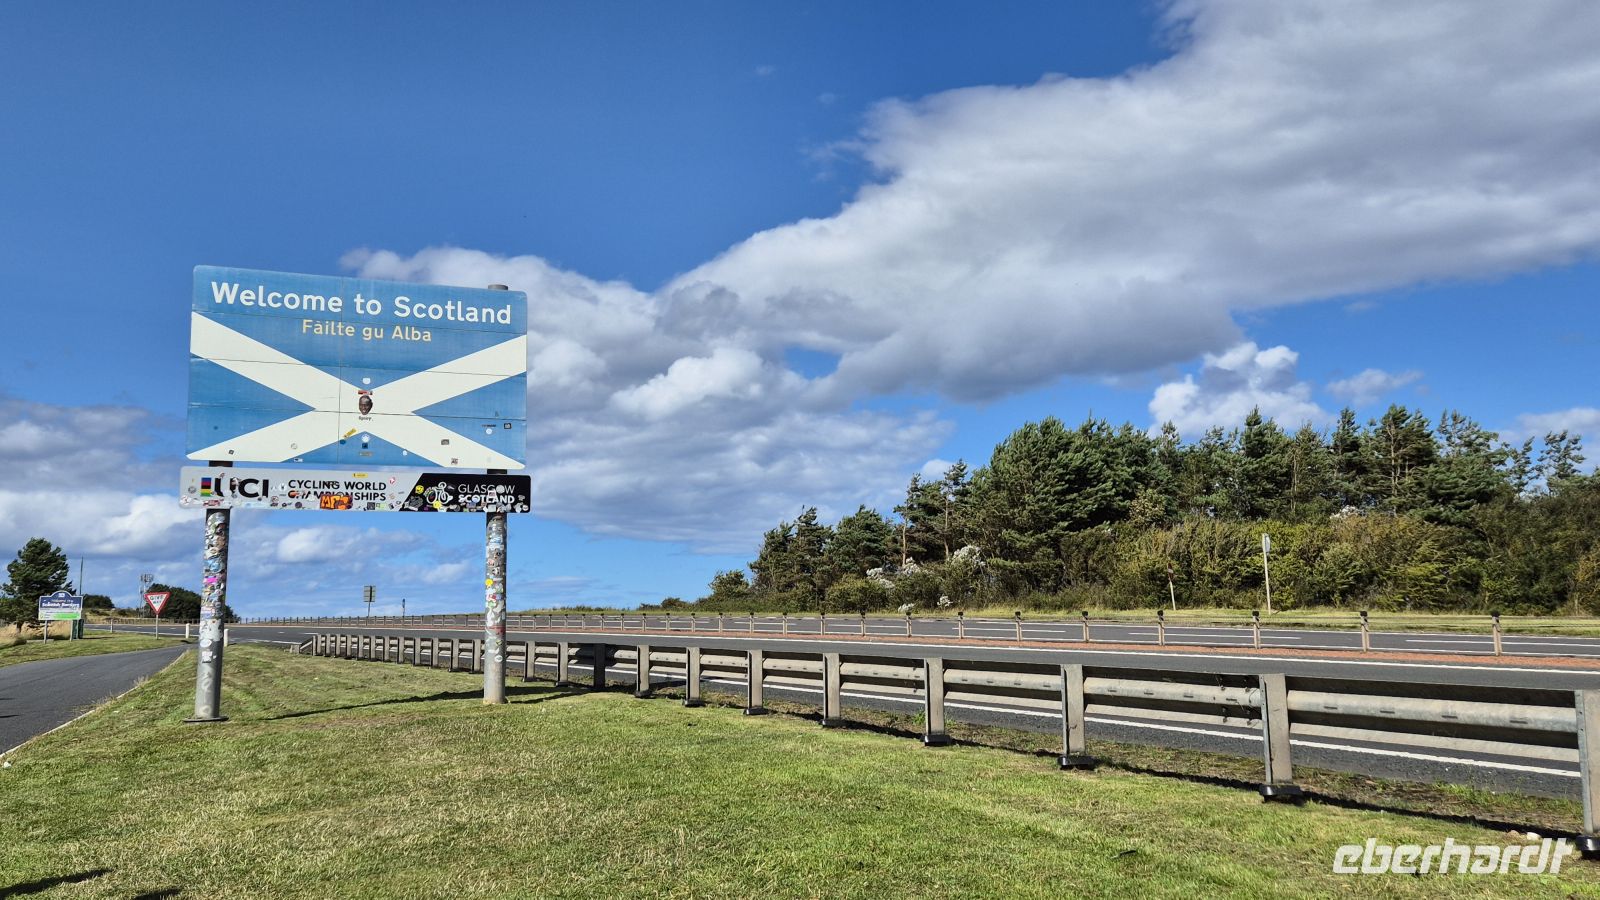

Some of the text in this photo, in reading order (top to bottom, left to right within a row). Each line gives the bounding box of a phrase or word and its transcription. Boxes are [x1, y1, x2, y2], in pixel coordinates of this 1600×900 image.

[211, 282, 511, 325] Welcome to Scotland
[302, 319, 432, 342] Fàilte gu Alba
[214, 478, 269, 498] UCI
[288, 479, 387, 491] CYCLING WORLD
[458, 484, 515, 494] GLASGW
[458, 494, 515, 504] SCOTLAND
